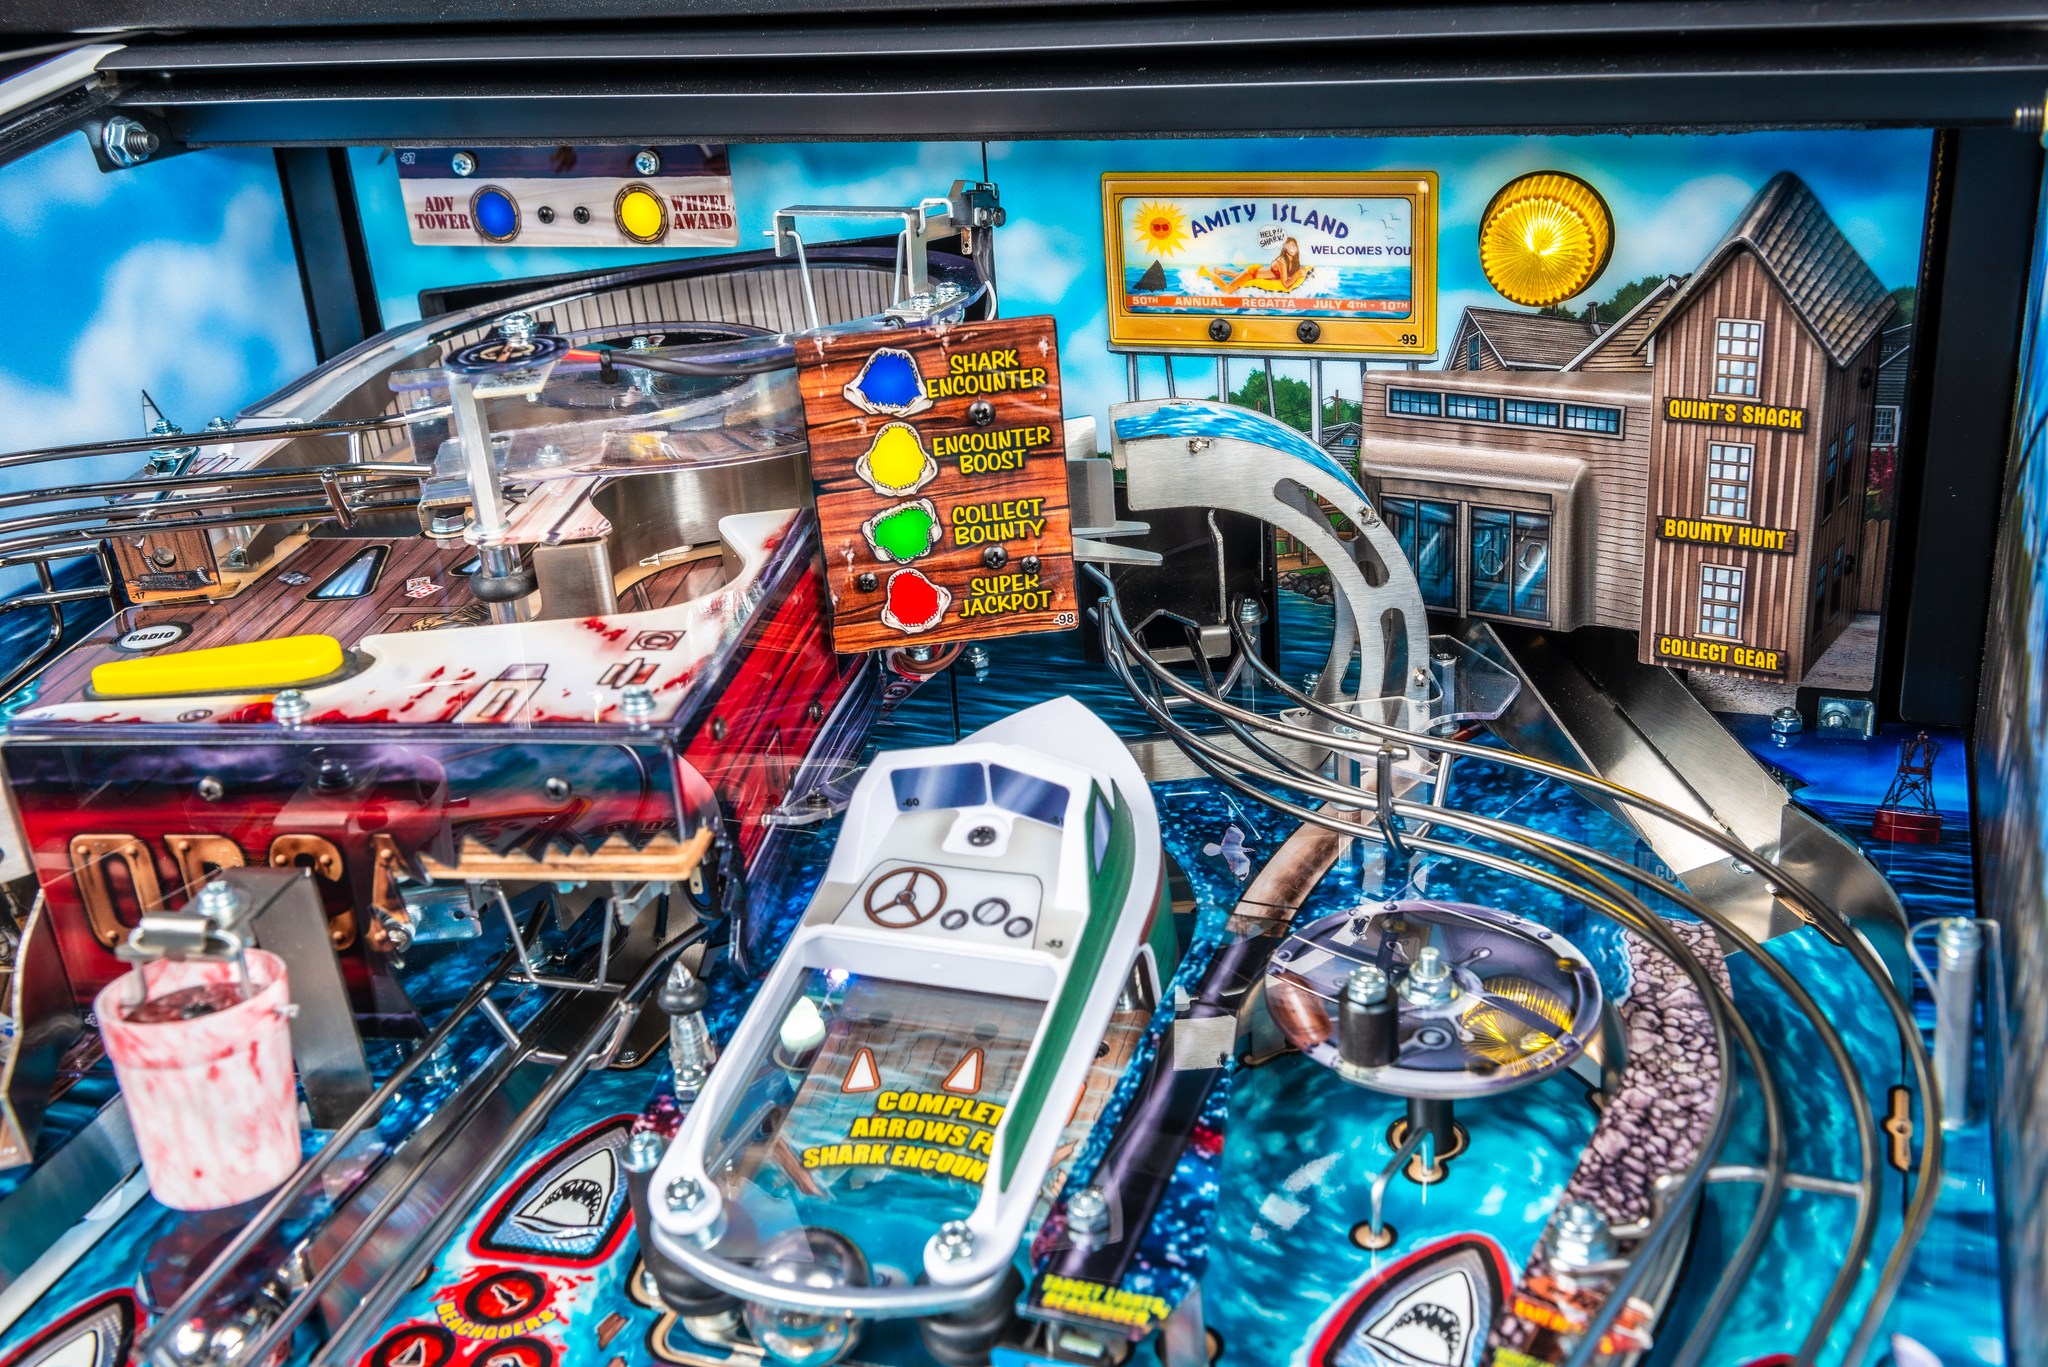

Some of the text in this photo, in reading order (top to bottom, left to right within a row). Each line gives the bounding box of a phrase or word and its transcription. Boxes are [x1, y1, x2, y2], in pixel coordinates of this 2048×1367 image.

[400, 152, 416, 165] -97
[424, 196, 454, 212] ADV
[670, 194, 733, 212] WHEEL
[415, 213, 471, 230] TOWER
[673, 212, 733, 230] AWARD
[1191, 203, 1349, 239] AMITY ISLAND
[1311, 244, 1412, 256] WELCOMES YOU
[1132, 296, 1159, 305] 50TH
[1175, 297, 1225, 307] ANNUAL
[1241, 298, 1296, 309] REGATTA
[1313, 301, 1342, 311] JULY
[1346, 302, 1367, 310] 4TH
[1380, 302, 1408, 311] 10TH
[1398, 334, 1418, 346] -99
[950, 350, 1019, 374] SHARK
[927, 367, 1047, 399] ENCOUNTER
[1669, 399, 1803, 429] QUINT'S SHACK
[932, 426, 1051, 457] ENCOUNTER
[959, 449, 1027, 475] BOOST
[952, 498, 1045, 525] COLLECT
[955, 519, 1046, 545] BOUNTY
[1664, 518, 1787, 550] BOUNTY HUNT
[970, 573, 1039, 597] SUPER
[960, 590, 1053, 618] JACKPOT
[1053, 612, 1076, 626] -98
[127, 630, 176, 642] RADIO
[1660, 637, 1778, 671] COLLECT GEAR
[877, 1090, 1007, 1127] COMPLET
[850, 1117, 971, 1148] ARROWS
[803, 1143, 989, 1185] SHARK ENCOUN
[436, 1300, 558, 1341] BEACHGOERS
